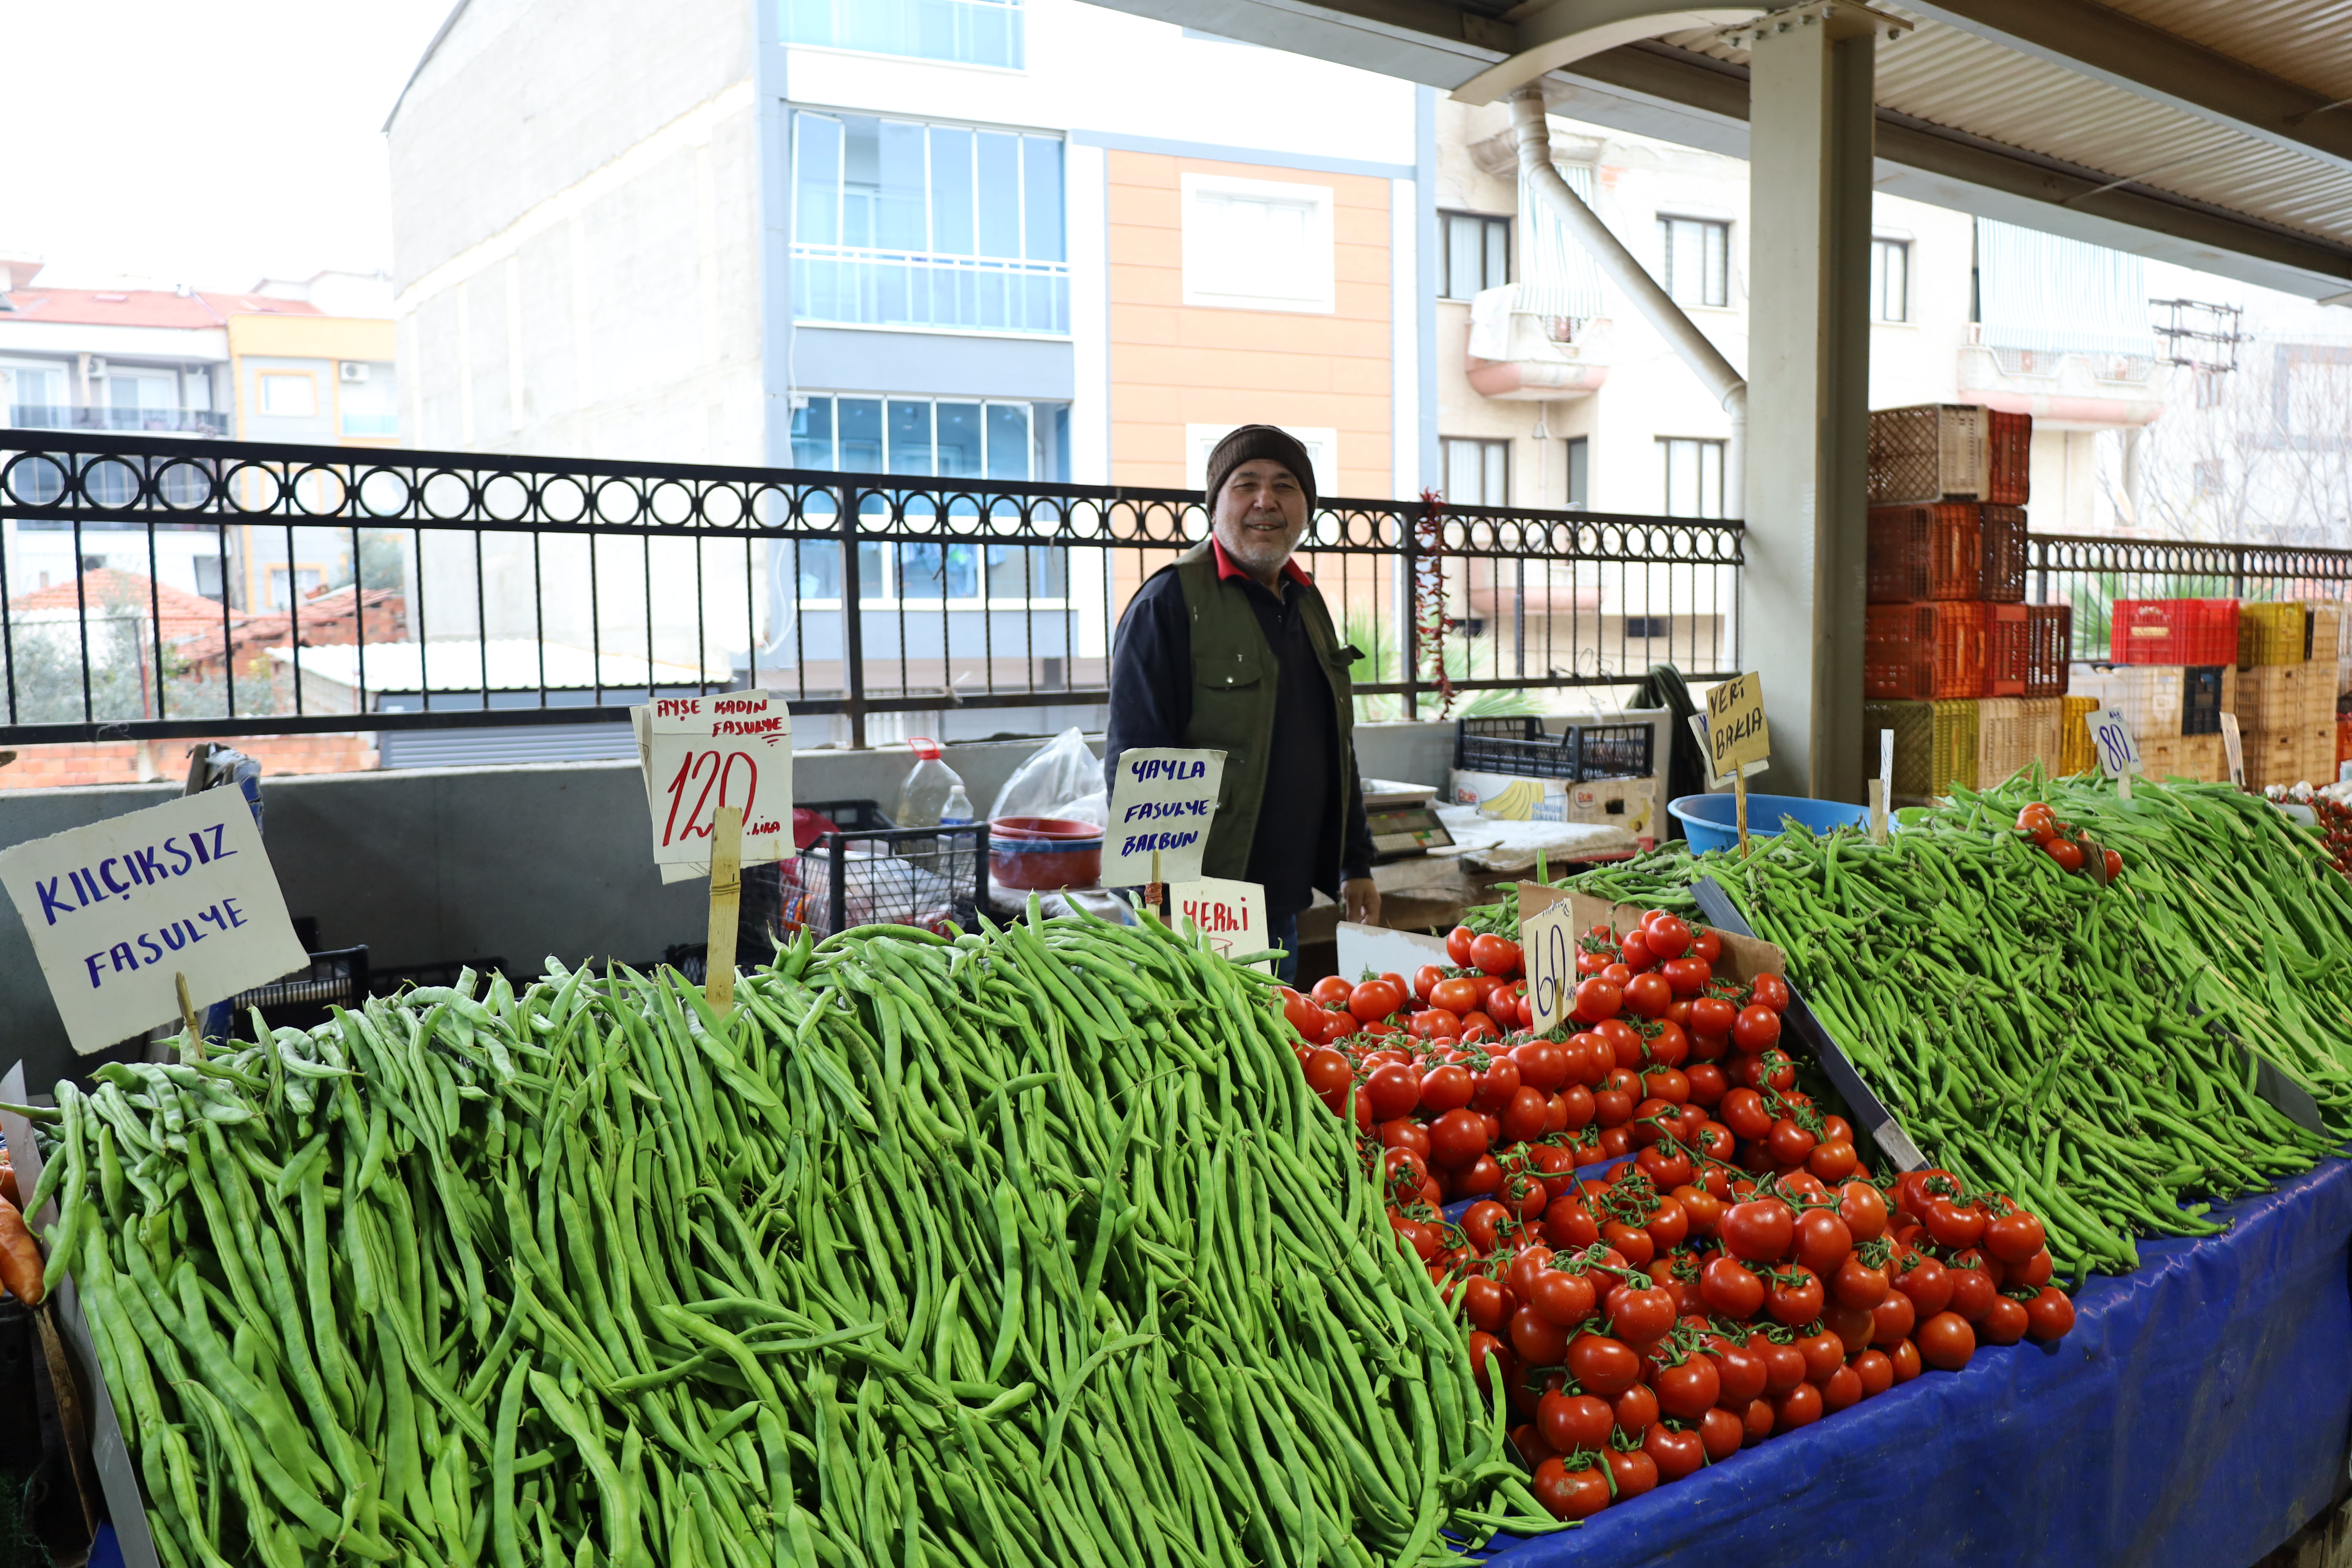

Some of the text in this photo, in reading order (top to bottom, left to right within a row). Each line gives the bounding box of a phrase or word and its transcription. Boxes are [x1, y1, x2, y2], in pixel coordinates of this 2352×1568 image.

[714, 699, 767, 715] KADIN
[712, 717, 783, 738] FASULYE
[2099, 724, 2131, 772] 80
[1132, 760, 1205, 782] YAYLA
[662, 750, 757, 847] 120
[1124, 799, 1210, 823] FASULYE
[1532, 803, 1562, 813] PREMIUM
[1121, 830, 1198, 857] BARBUN
[35, 824, 238, 926] KILÇIKSIZ
[84, 898, 248, 989] FASULYE
[1535, 924, 1566, 1017] 60
